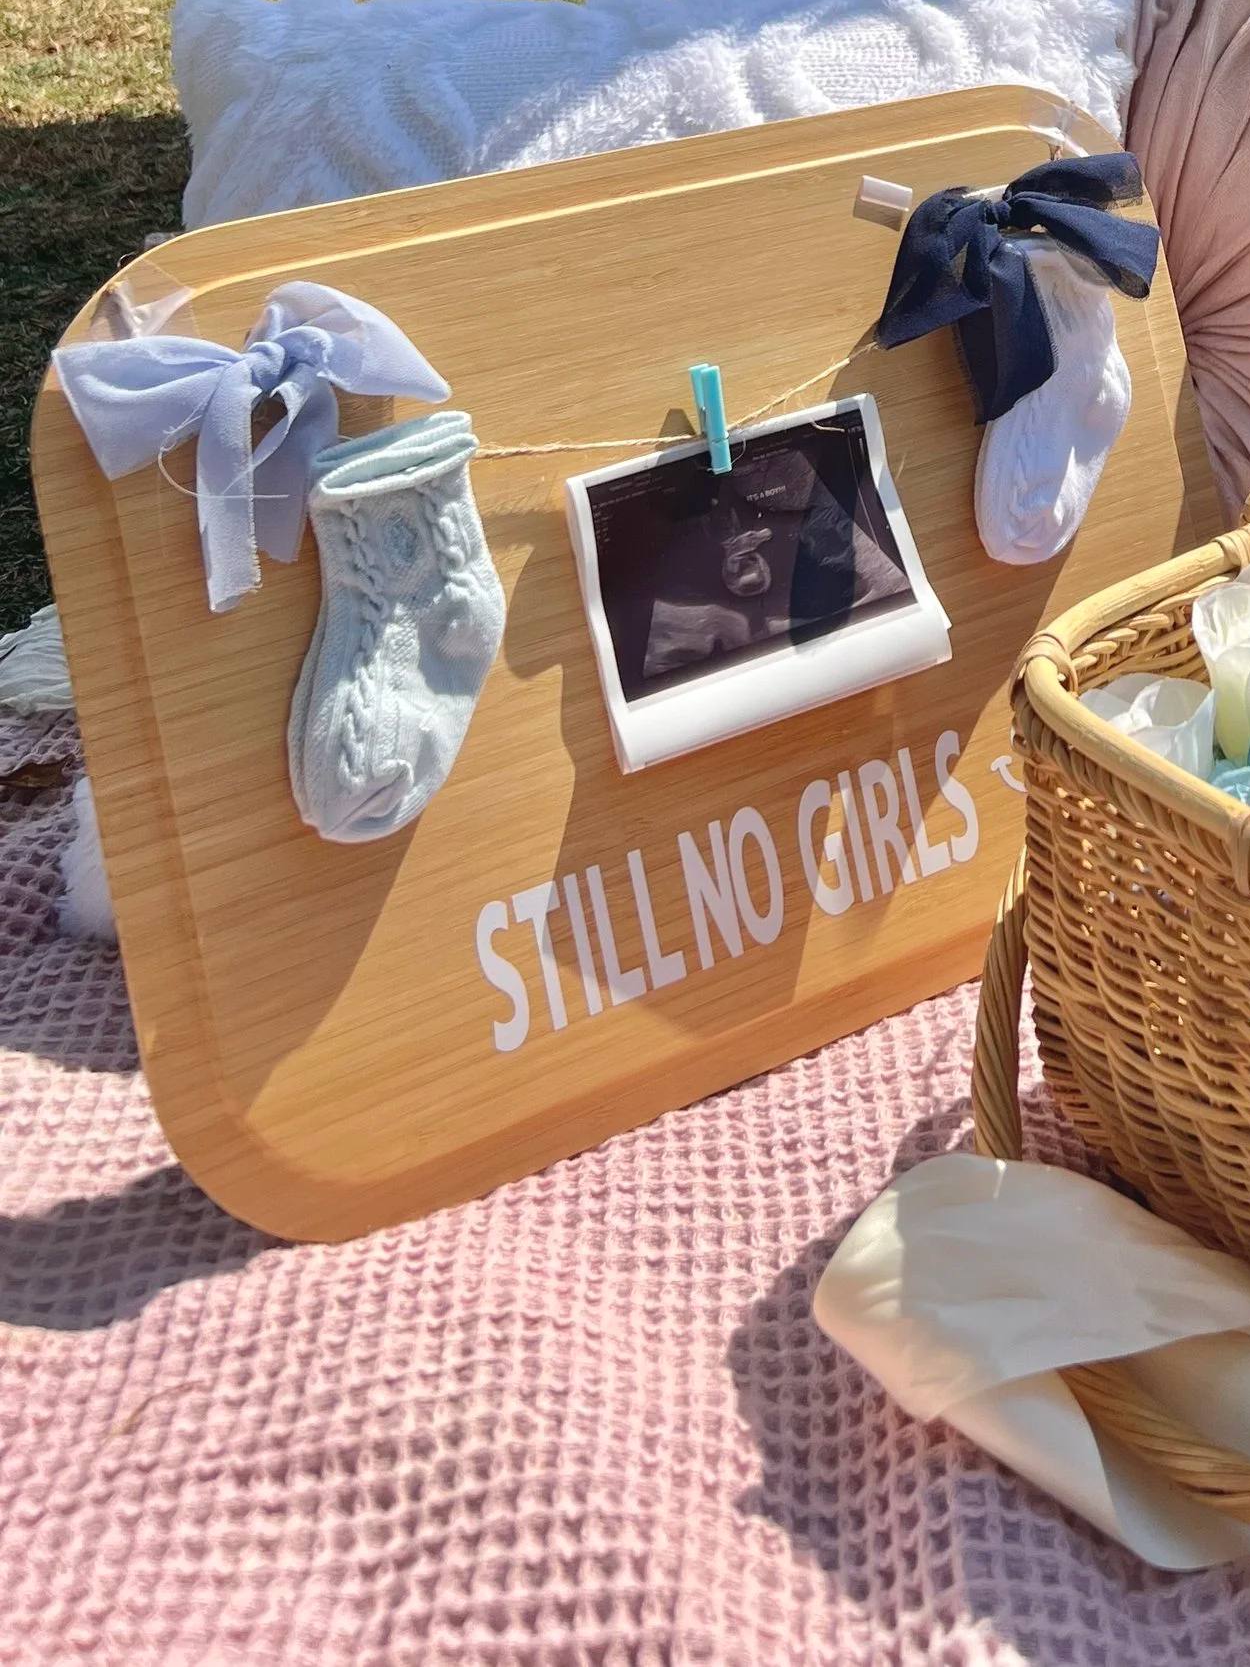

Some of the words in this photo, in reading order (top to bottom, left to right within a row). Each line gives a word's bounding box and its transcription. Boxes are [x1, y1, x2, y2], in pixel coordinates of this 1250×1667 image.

[475, 849, 687, 1052] STILL
[678, 806, 785, 970] NO
[798, 730, 980, 916] GIRLS
